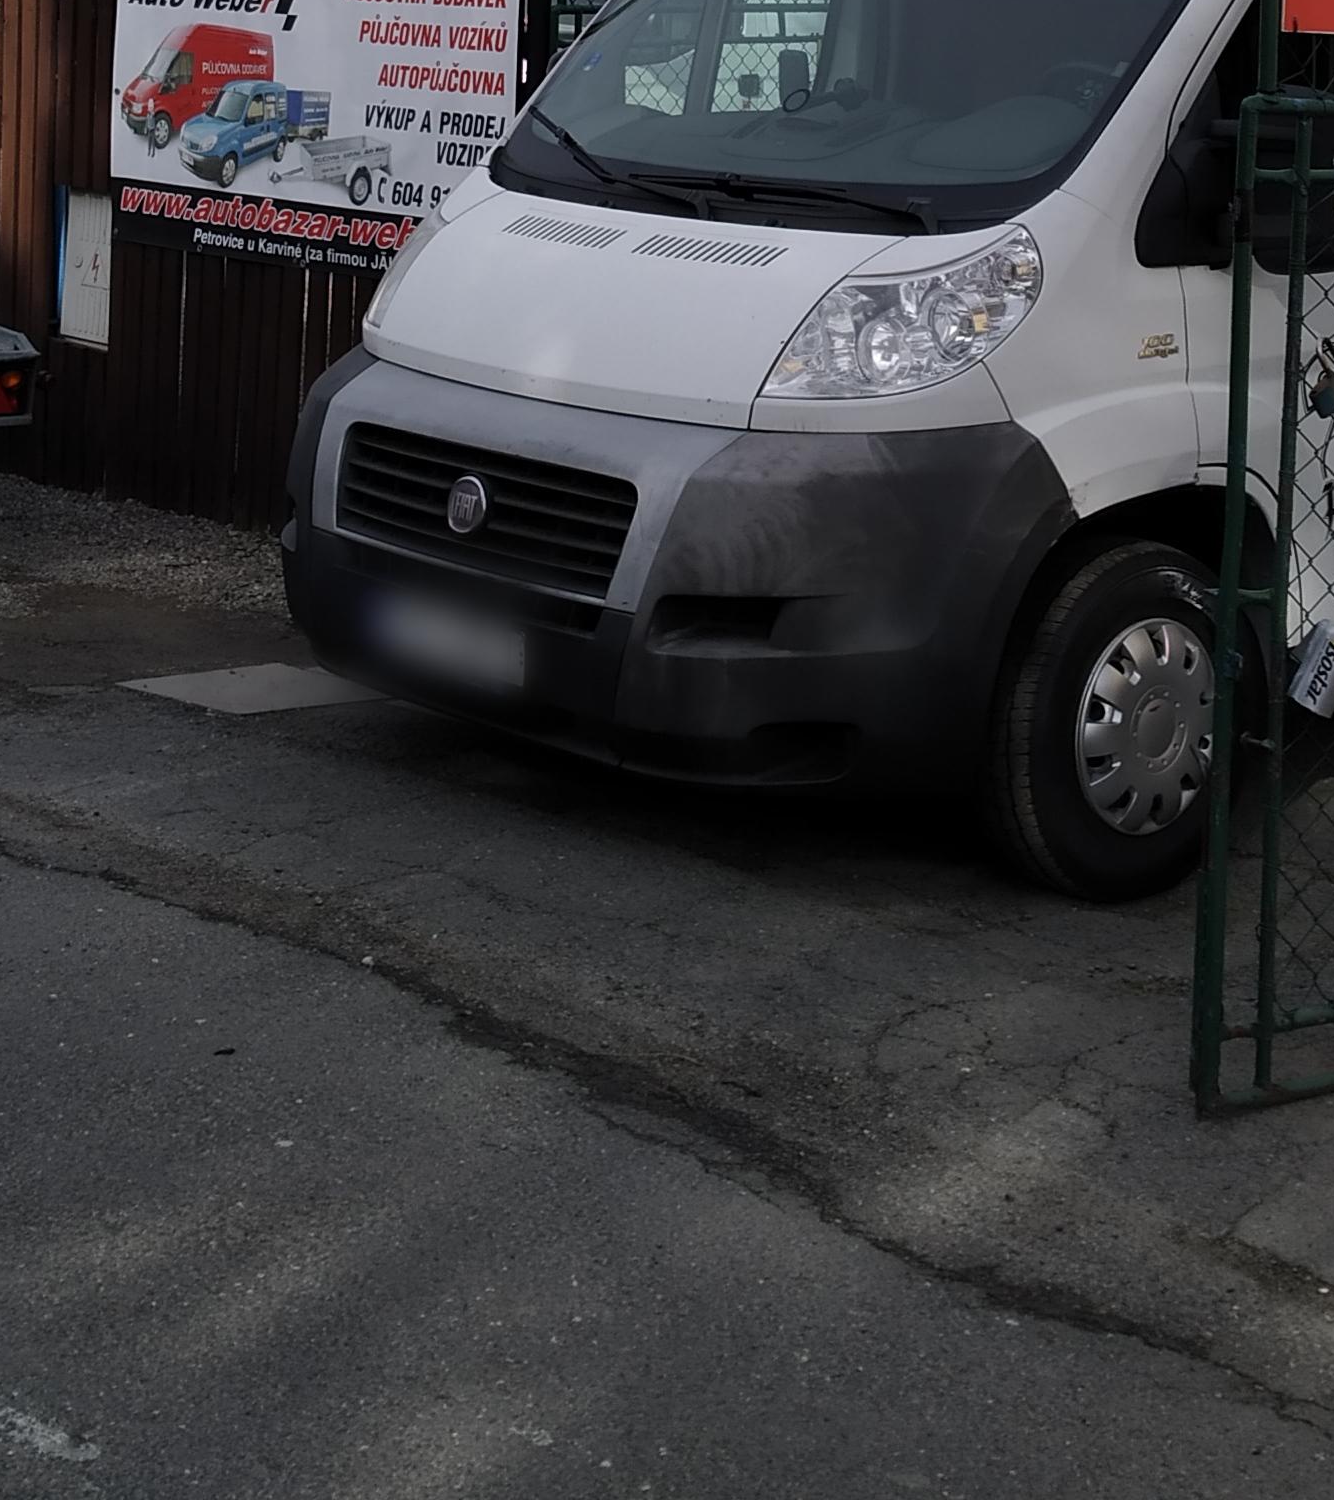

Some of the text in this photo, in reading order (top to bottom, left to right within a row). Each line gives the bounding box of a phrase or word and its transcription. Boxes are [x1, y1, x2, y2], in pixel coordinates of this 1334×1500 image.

[359, 14, 508, 53] PŮJČOVNA VOZÍKŮ
[378, 60, 505, 97] AUTOPŮJČOVNA
[365, 99, 506, 140] VÝKUP A PRODEJ
[391, 180, 424, 207] 604
[193, 227, 245, 251] Petrovice
[247, 239, 255, 252] u
[258, 239, 302, 259] Karviné
[305, 247, 324, 264] (za
[326, 248, 367, 268] firmou
